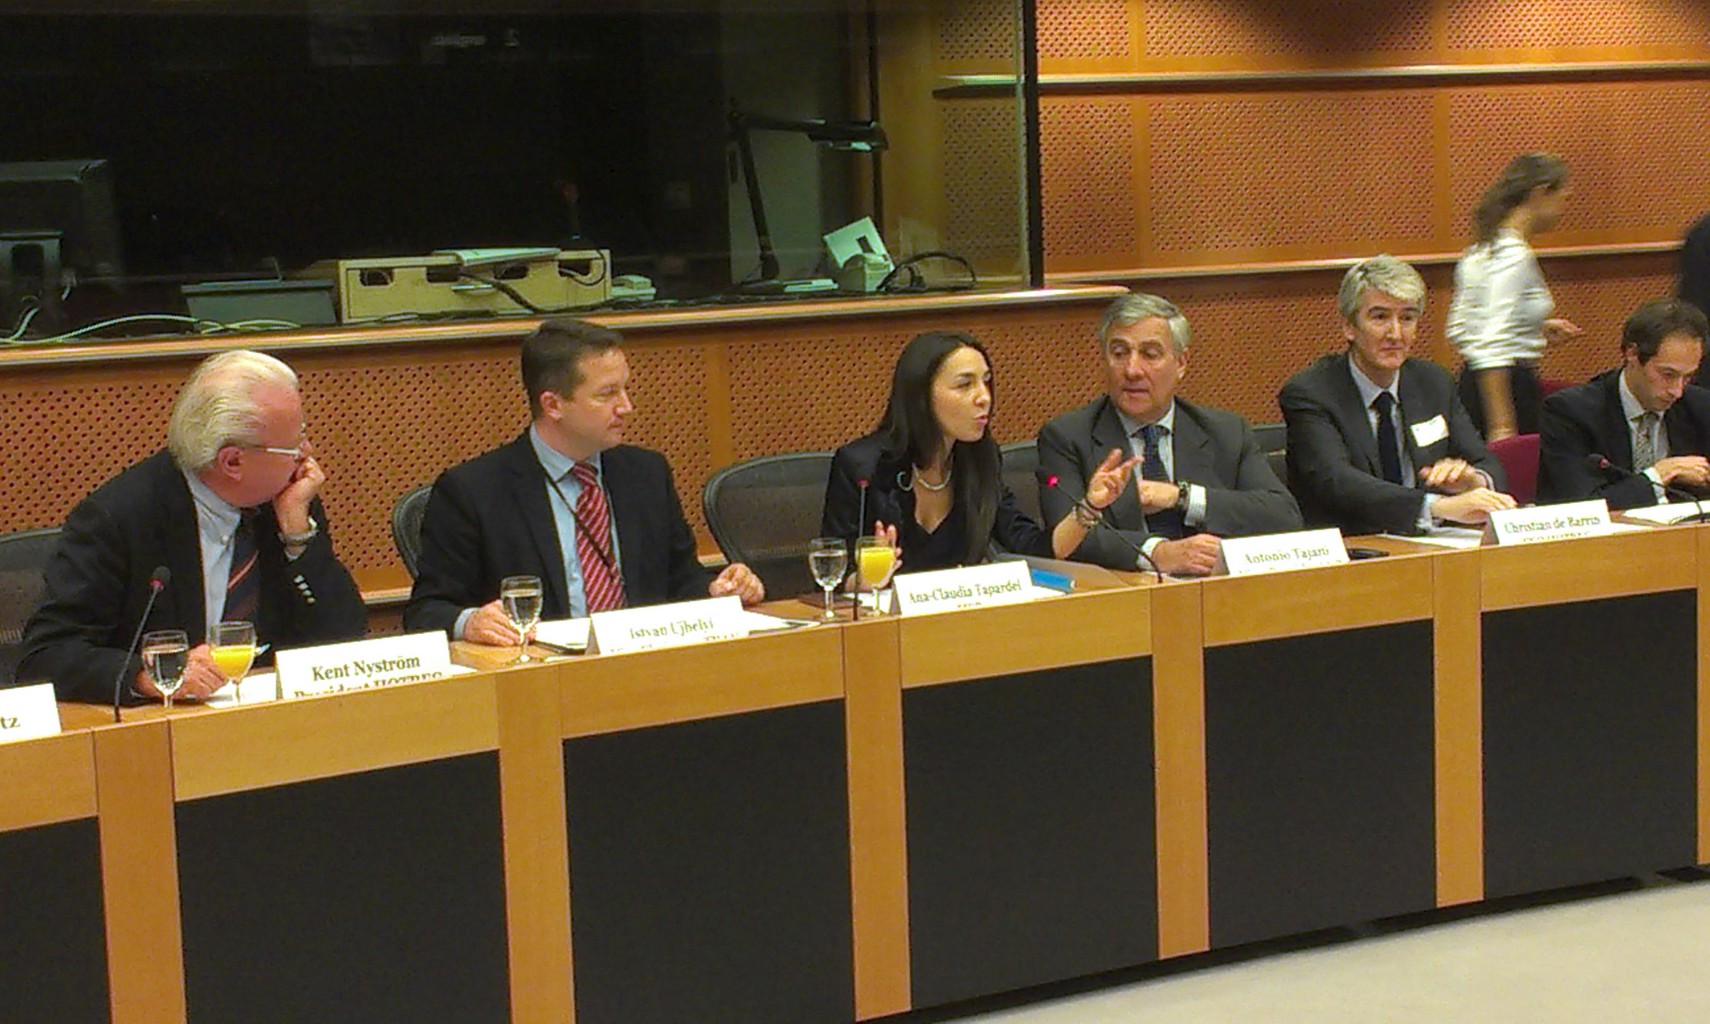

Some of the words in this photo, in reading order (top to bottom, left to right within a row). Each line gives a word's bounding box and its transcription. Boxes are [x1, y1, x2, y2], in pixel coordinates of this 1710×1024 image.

[1504, 518, 1552, 534] Christian
[1553, 517, 1566, 529] de
[1245, 549, 1290, 564] Antonio
[909, 583, 973, 604] Ana-Claudia
[629, 625, 668, 640] Istvan
[311, 663, 350, 682] Kent
[353, 655, 421, 678] Nyström
